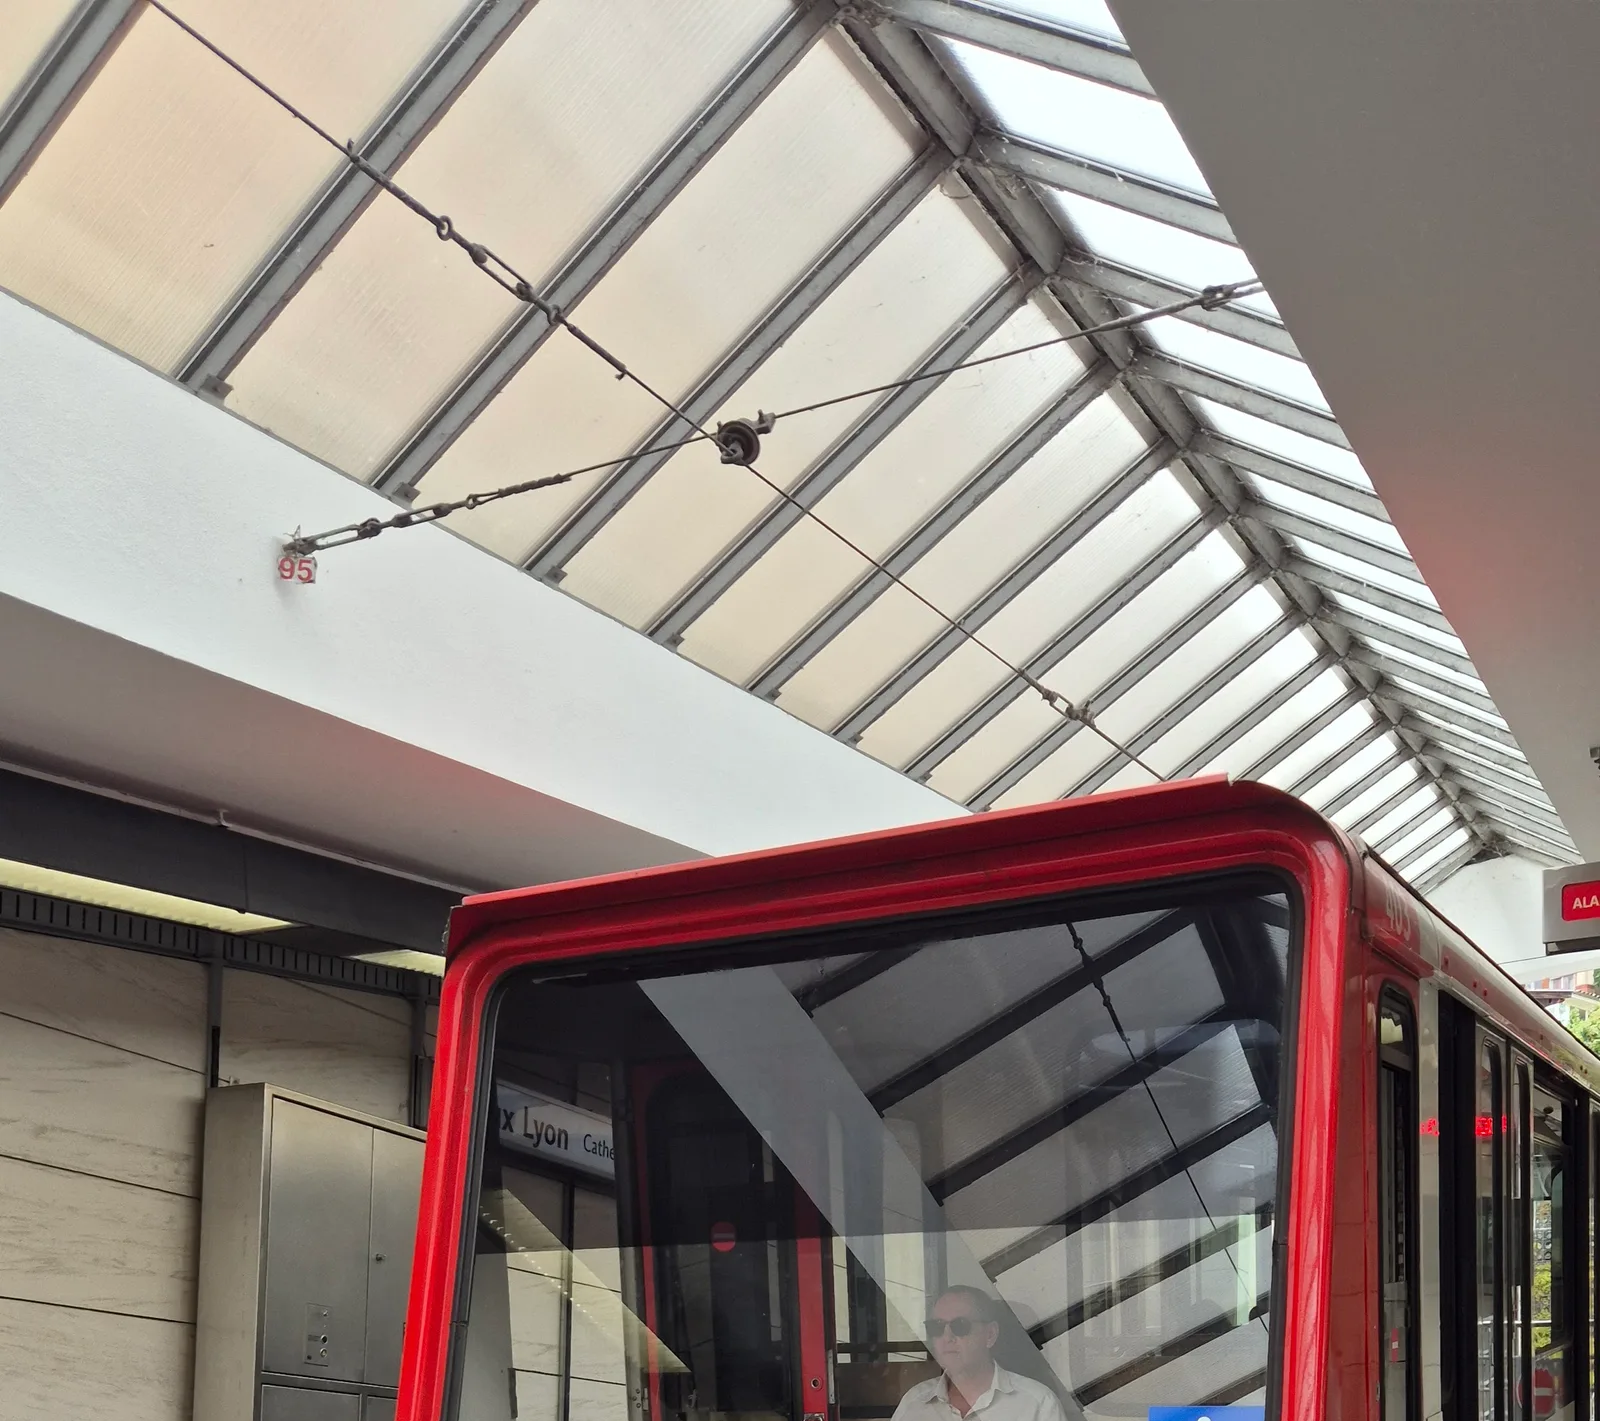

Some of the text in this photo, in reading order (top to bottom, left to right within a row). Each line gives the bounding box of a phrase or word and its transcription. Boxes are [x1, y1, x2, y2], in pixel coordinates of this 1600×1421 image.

[279, 557, 313, 582] 95
[1572, 895, 1600, 910] ALA
[523, 1106, 569, 1150] Lyon
